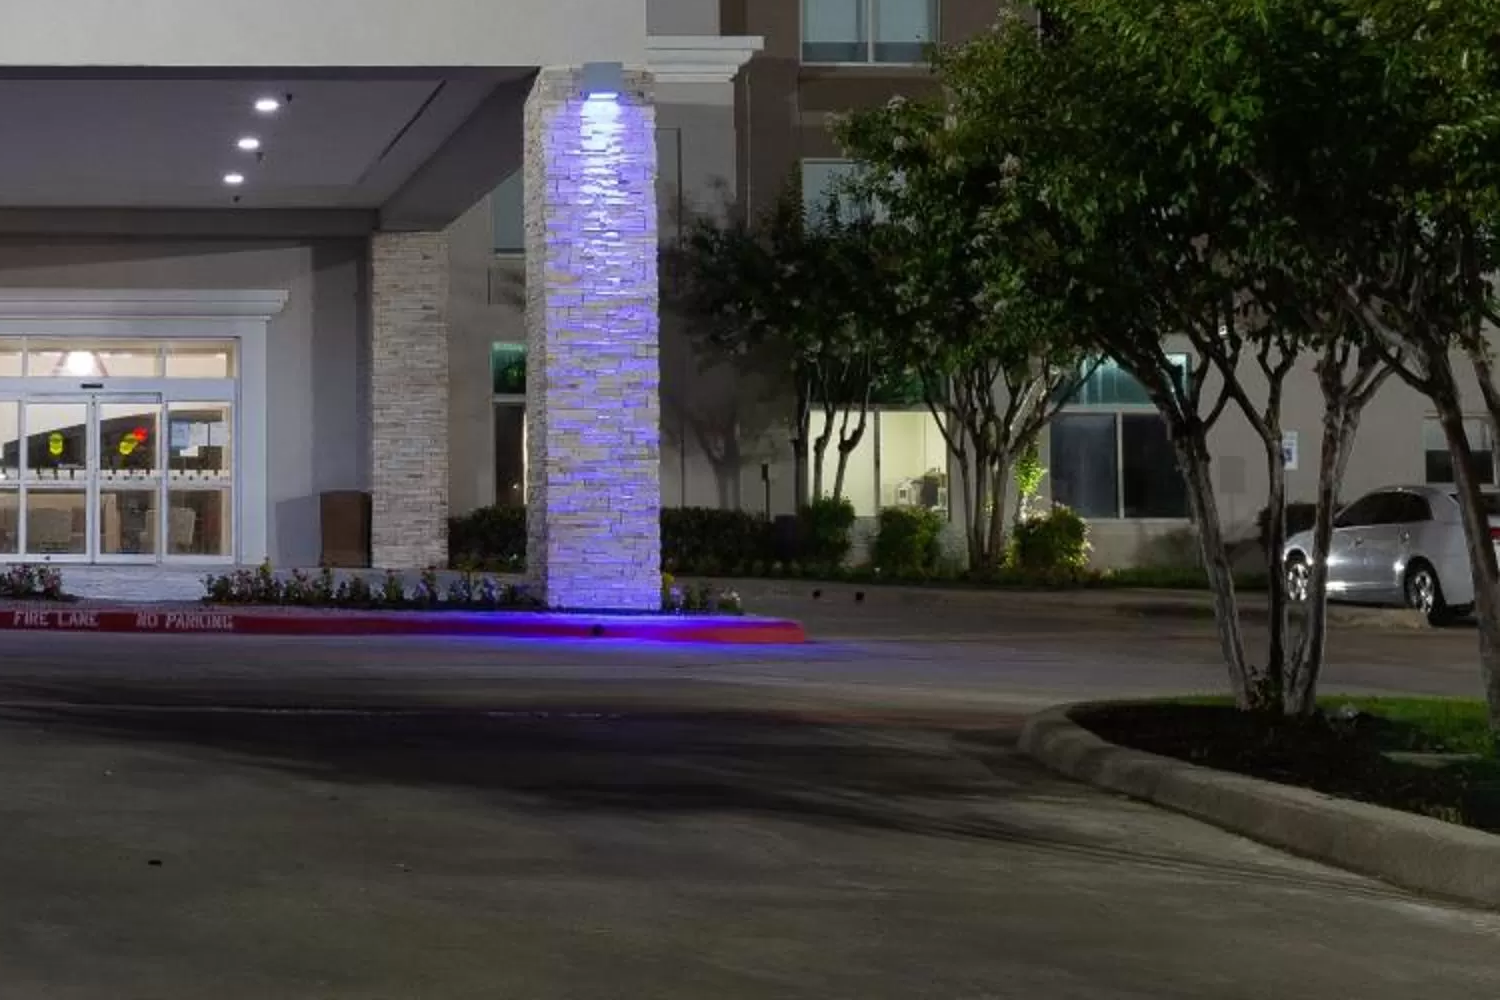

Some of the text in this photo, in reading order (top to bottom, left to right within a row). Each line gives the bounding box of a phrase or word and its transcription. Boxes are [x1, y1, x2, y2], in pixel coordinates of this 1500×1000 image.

[13, 611, 233, 629] FIRE LANE NO PARKING
